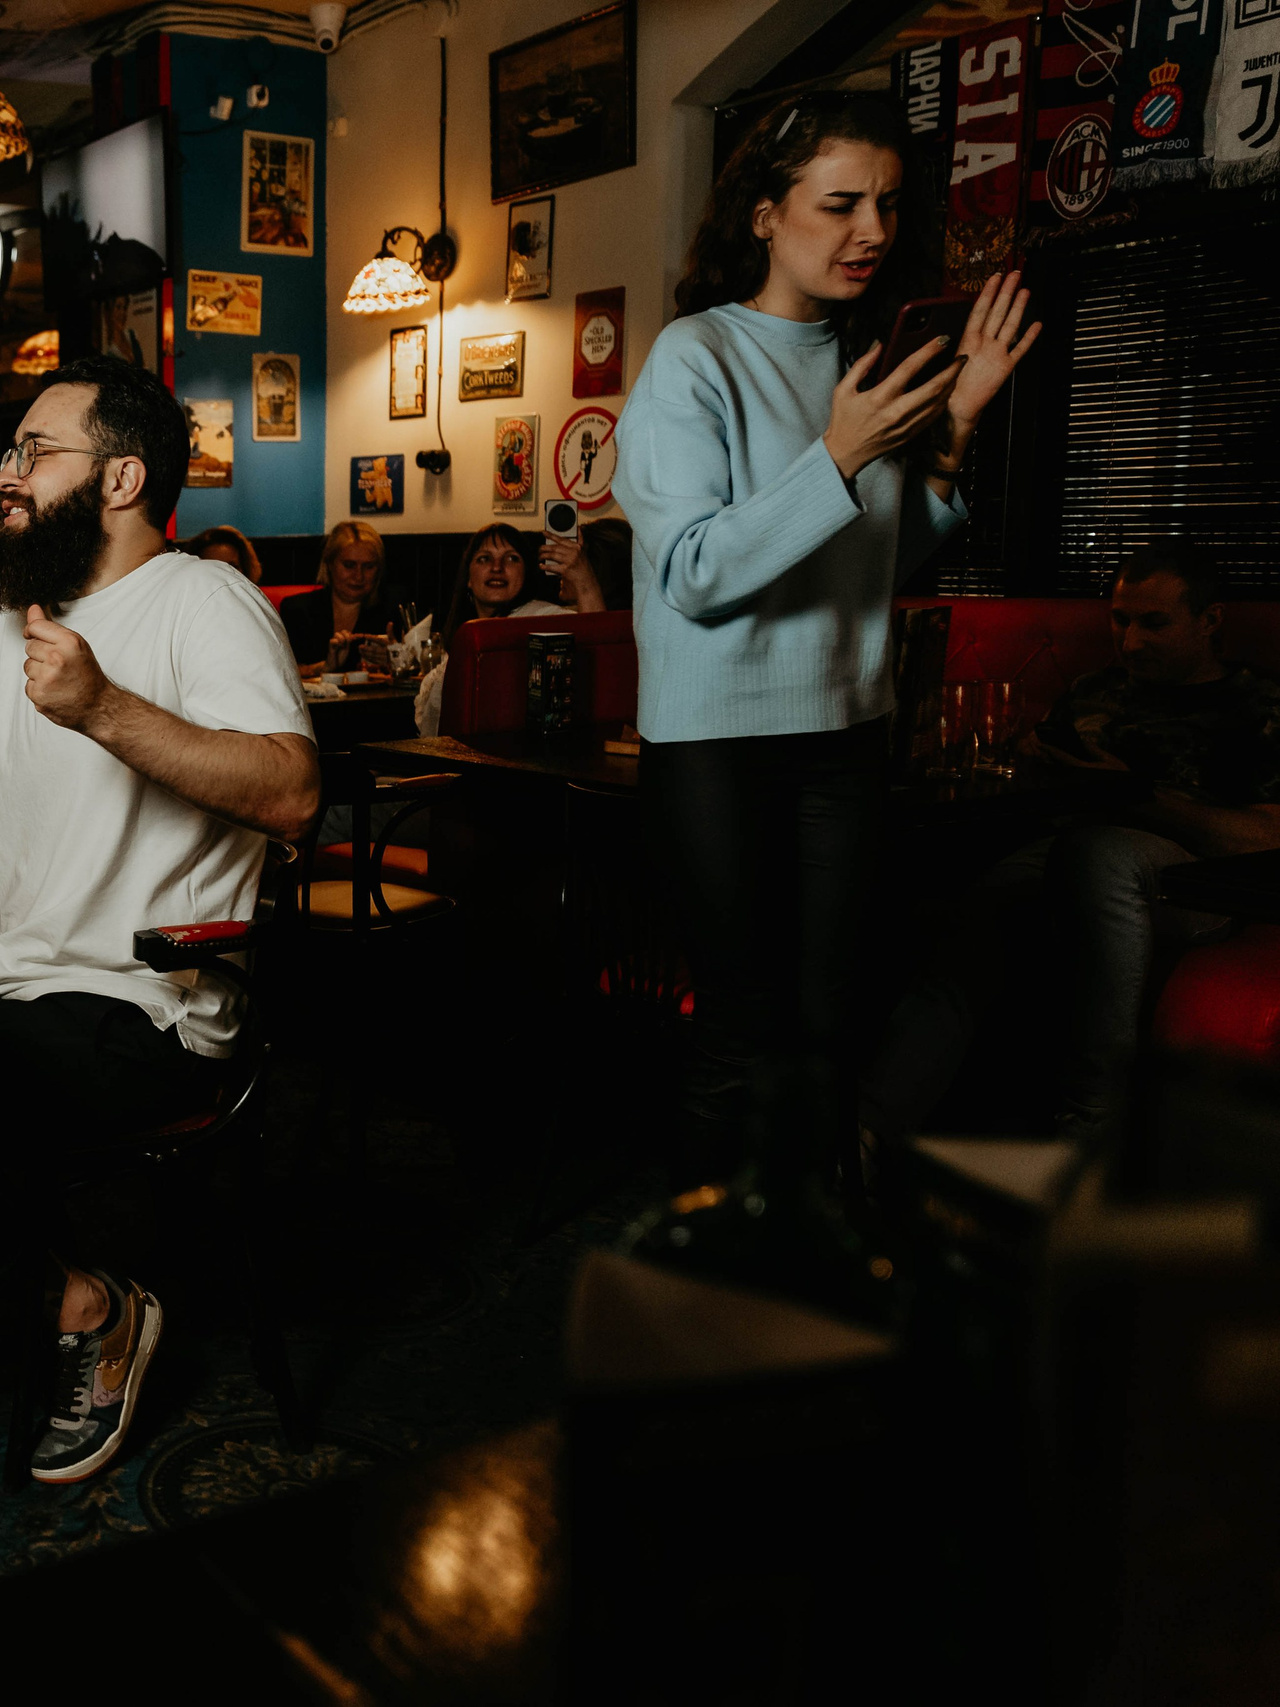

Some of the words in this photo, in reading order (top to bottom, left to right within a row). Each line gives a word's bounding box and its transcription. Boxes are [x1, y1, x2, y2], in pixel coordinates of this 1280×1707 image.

[1243, 51, 1280, 72] JUVENT
[950, 36, 1022, 186] SIA
[1069, 124, 1103, 143] ACM
[1122, 141, 1162, 158] SINCE
[1162, 137, 1190, 150] 1900
[1063, 192, 1095, 206] 1899
